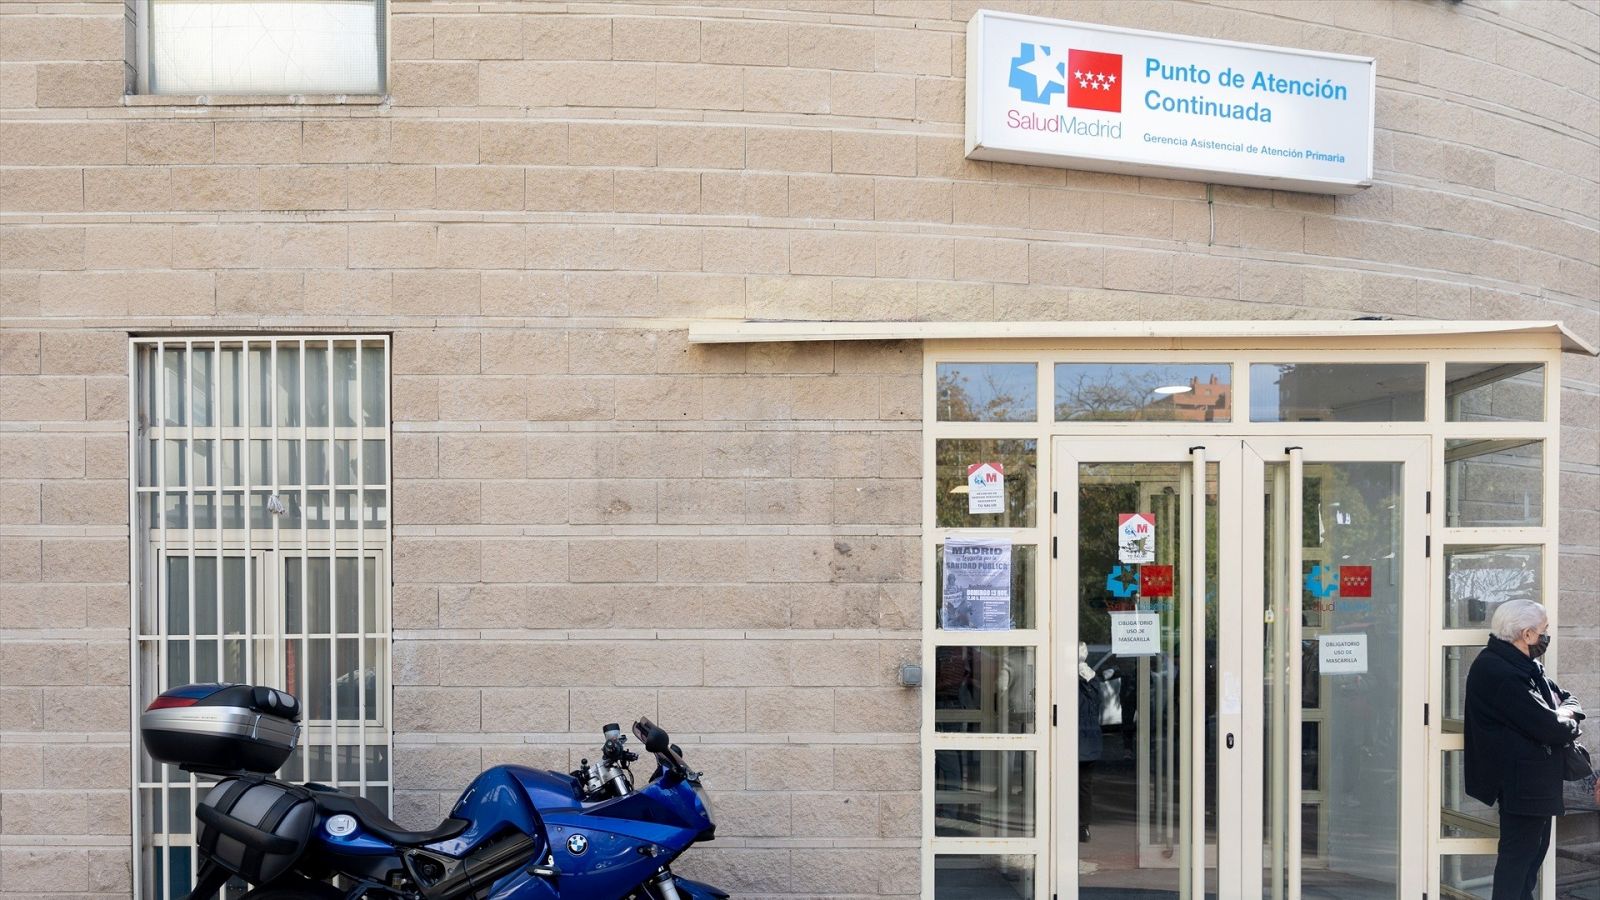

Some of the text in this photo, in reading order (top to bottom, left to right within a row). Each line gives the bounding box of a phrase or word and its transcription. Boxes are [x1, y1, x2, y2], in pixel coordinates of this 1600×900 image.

[1145, 57, 1348, 101] Punto de Atención
[1144, 89, 1272, 123] Continuada
[1007, 109, 1122, 140] SaludMadrid
[1143, 132, 1345, 164] Gerencia Asistencial de Atención Primaria
[985, 473, 997, 483] M
[1136, 524, 1148, 533] M
[952, 547, 1003, 556] MADRID
[946, 562, 977, 570] SANIDAD
